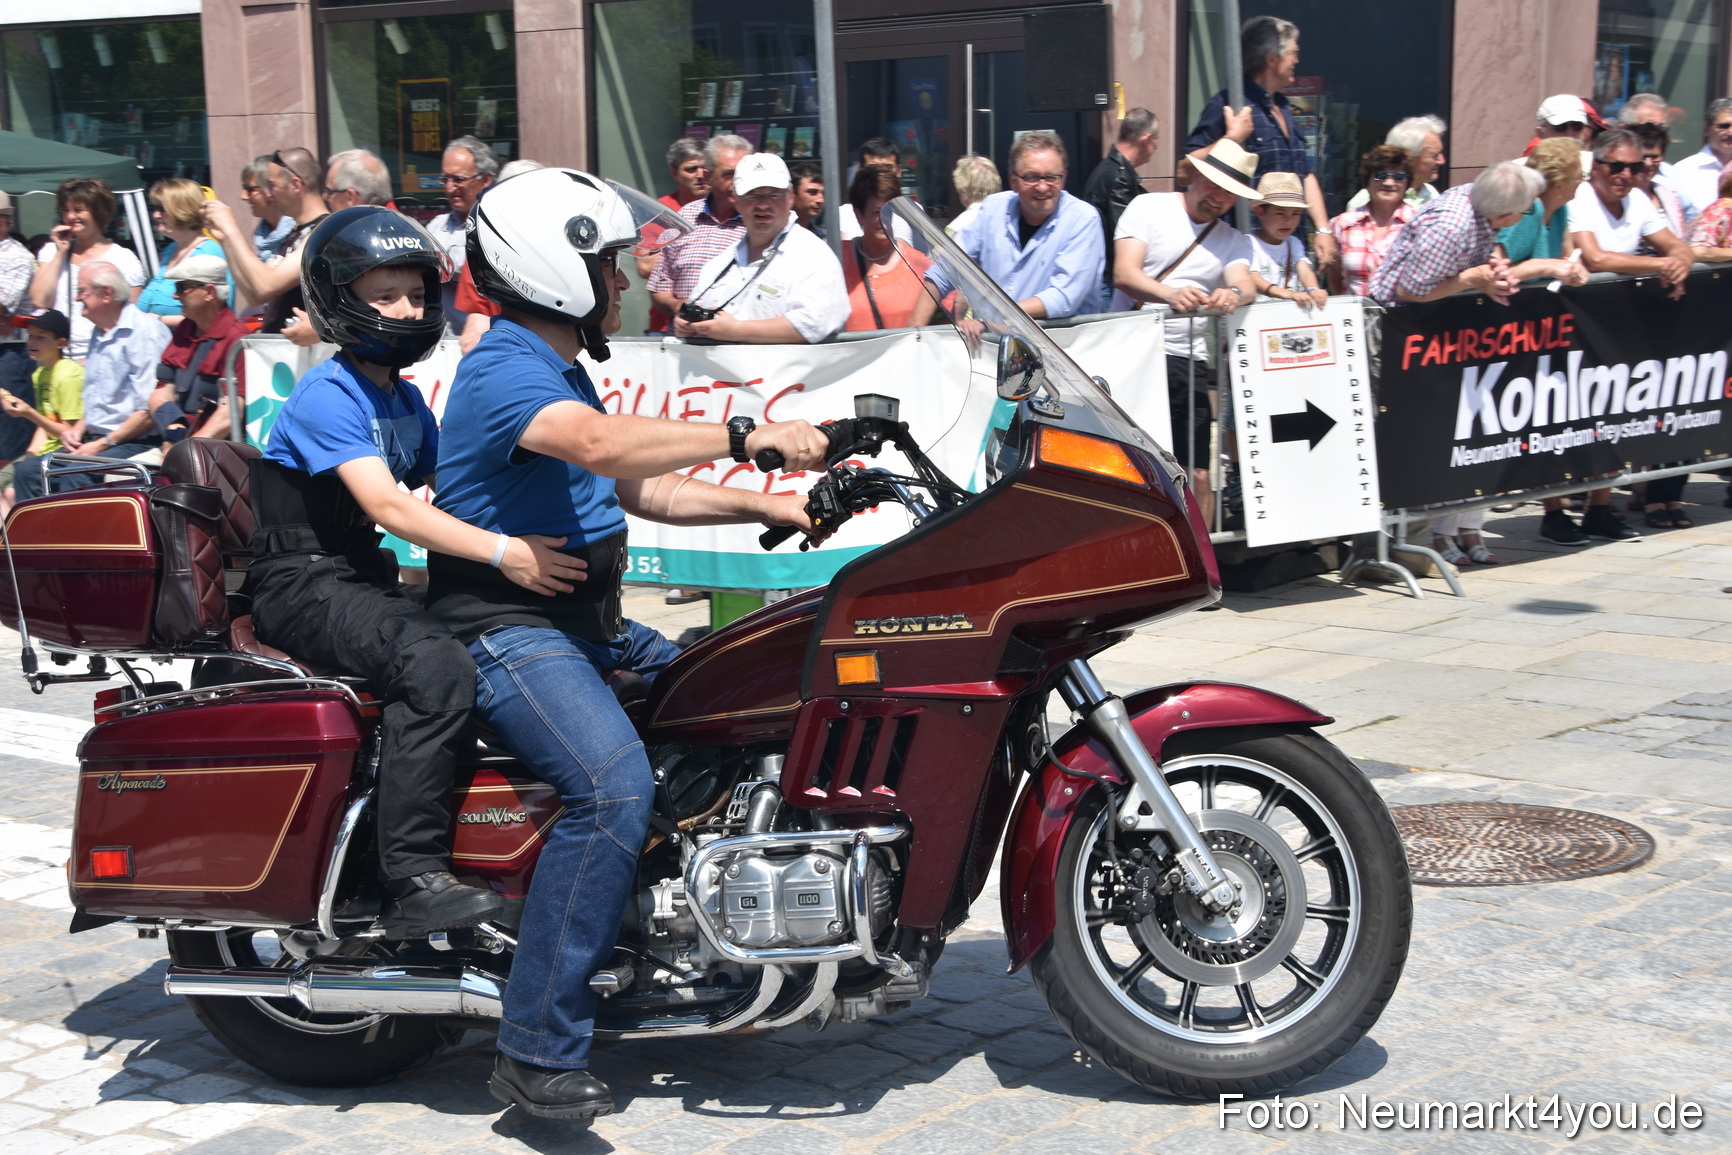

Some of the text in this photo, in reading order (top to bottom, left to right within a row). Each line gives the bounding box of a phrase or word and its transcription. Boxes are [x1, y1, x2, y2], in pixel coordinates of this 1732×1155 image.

[381, 236, 423, 250] uvex
[1401, 313, 1575, 371] FAHRSCHULE
[1453, 350, 1728, 440] Kohlmann
[1236, 328, 1267, 520] RESIDENZPLATZ
[1343, 318, 1371, 506] RESIDENZPLATZ
[1450, 437, 1522, 468] Neumarkt
[1595, 415, 1656, 444] Freystadt
[1661, 409, 1722, 436] Pyrbaum
[637, 556, 662, 574] 52
[853, 613, 974, 636] HONDA
[98, 770, 167, 794] Aspencade
[458, 806, 527, 827] GOLDWING
[741, 894, 819, 907] GL 1100
